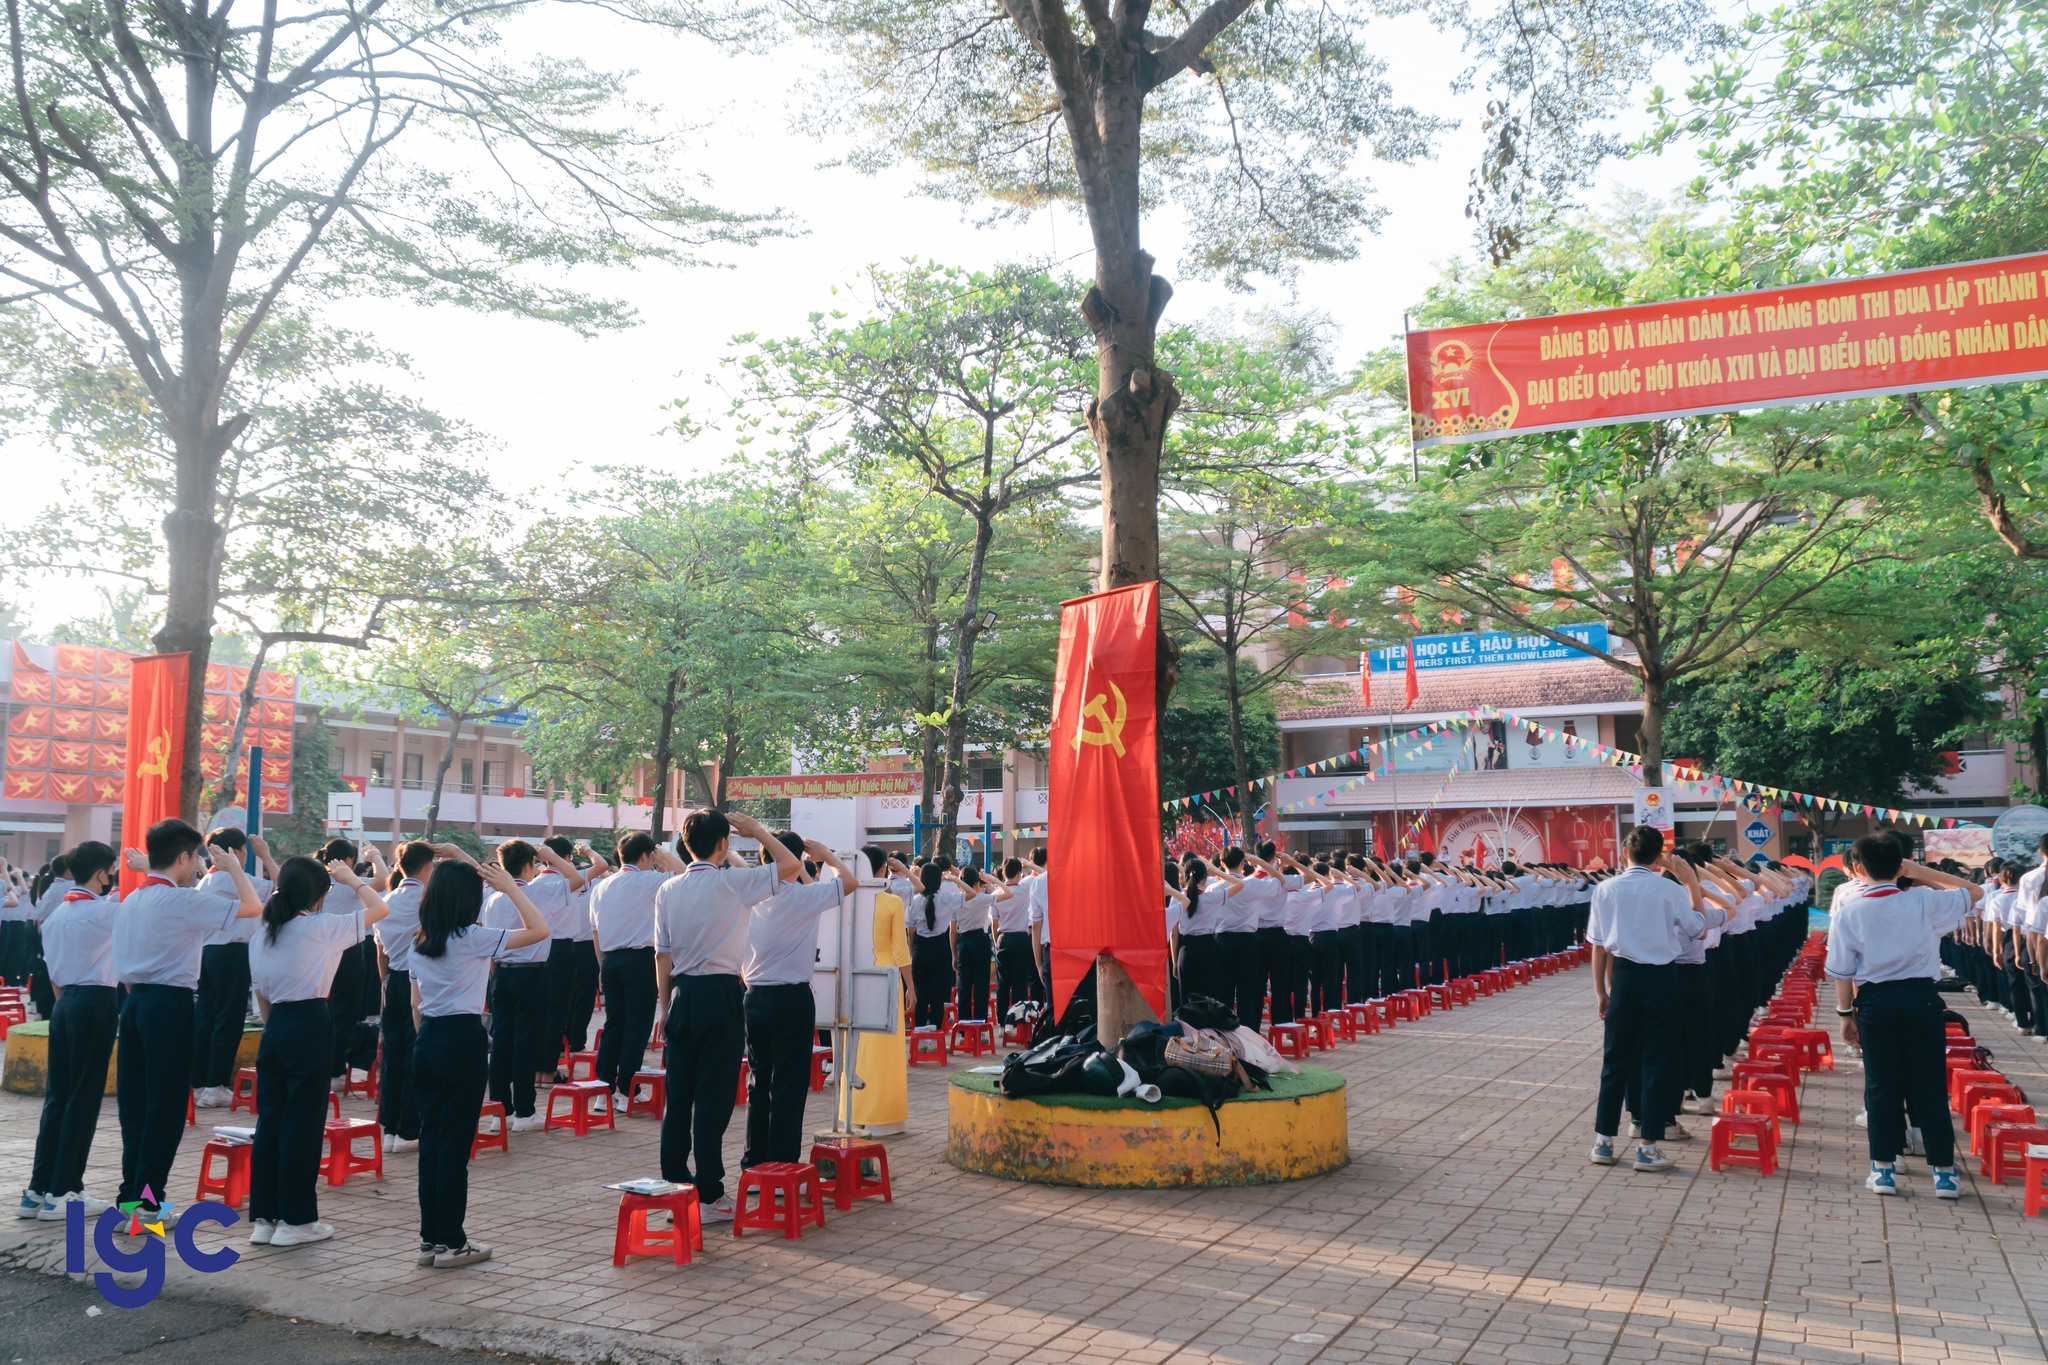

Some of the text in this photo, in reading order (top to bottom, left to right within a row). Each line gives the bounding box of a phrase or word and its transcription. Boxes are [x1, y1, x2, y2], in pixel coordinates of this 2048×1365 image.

[1540, 326, 1583, 361] ĐẢNG
[1588, 322, 1609, 358] BỘ
[1613, 319, 1634, 350] VÀ
[1639, 313, 1685, 346] NHÂN
[1688, 308, 1723, 341] DÂN
[1728, 304, 1751, 337] XÃ
[1755, 295, 1812, 333] TRẢNG
[1817, 295, 1858, 325] BOM
[1861, 290, 1890, 319] THI
[1894, 286, 1931, 317] ĐUA
[1935, 276, 1970, 317] LẬP
[1974, 270, 2038, 306] THÀNH
[1527, 378, 1554, 409] ĐẠI
[1558, 364, 1595, 402] BIỂU
[1599, 359, 1641, 400] QUỐC
[1645, 358, 1673, 396] HỘI
[1677, 353, 1723, 388] KHÓA
[1727, 352, 1755, 382] XVI
[1758, 344, 1782, 379] VÀ
[1785, 347, 1815, 380] ĐẠI
[1820, 331, 1861, 371] BIỂU
[1865, 331, 1896, 371] HỘI
[1900, 323, 1951, 363] ĐỒNG
[1955, 319, 2010, 356] NHÂN
[1432, 387, 1470, 409] XVI
[1416, 643, 1448, 659] HỌC
[1452, 637, 1475, 654] LỄ,
[1480, 636, 1512, 654] HẬU
[1516, 634, 1550, 651] HỌC
[1478, 653, 1504, 663] THEN
[1506, 648, 1569, 661] KNOWLEDGE
[1747, 828, 1769, 839] KHÁT
